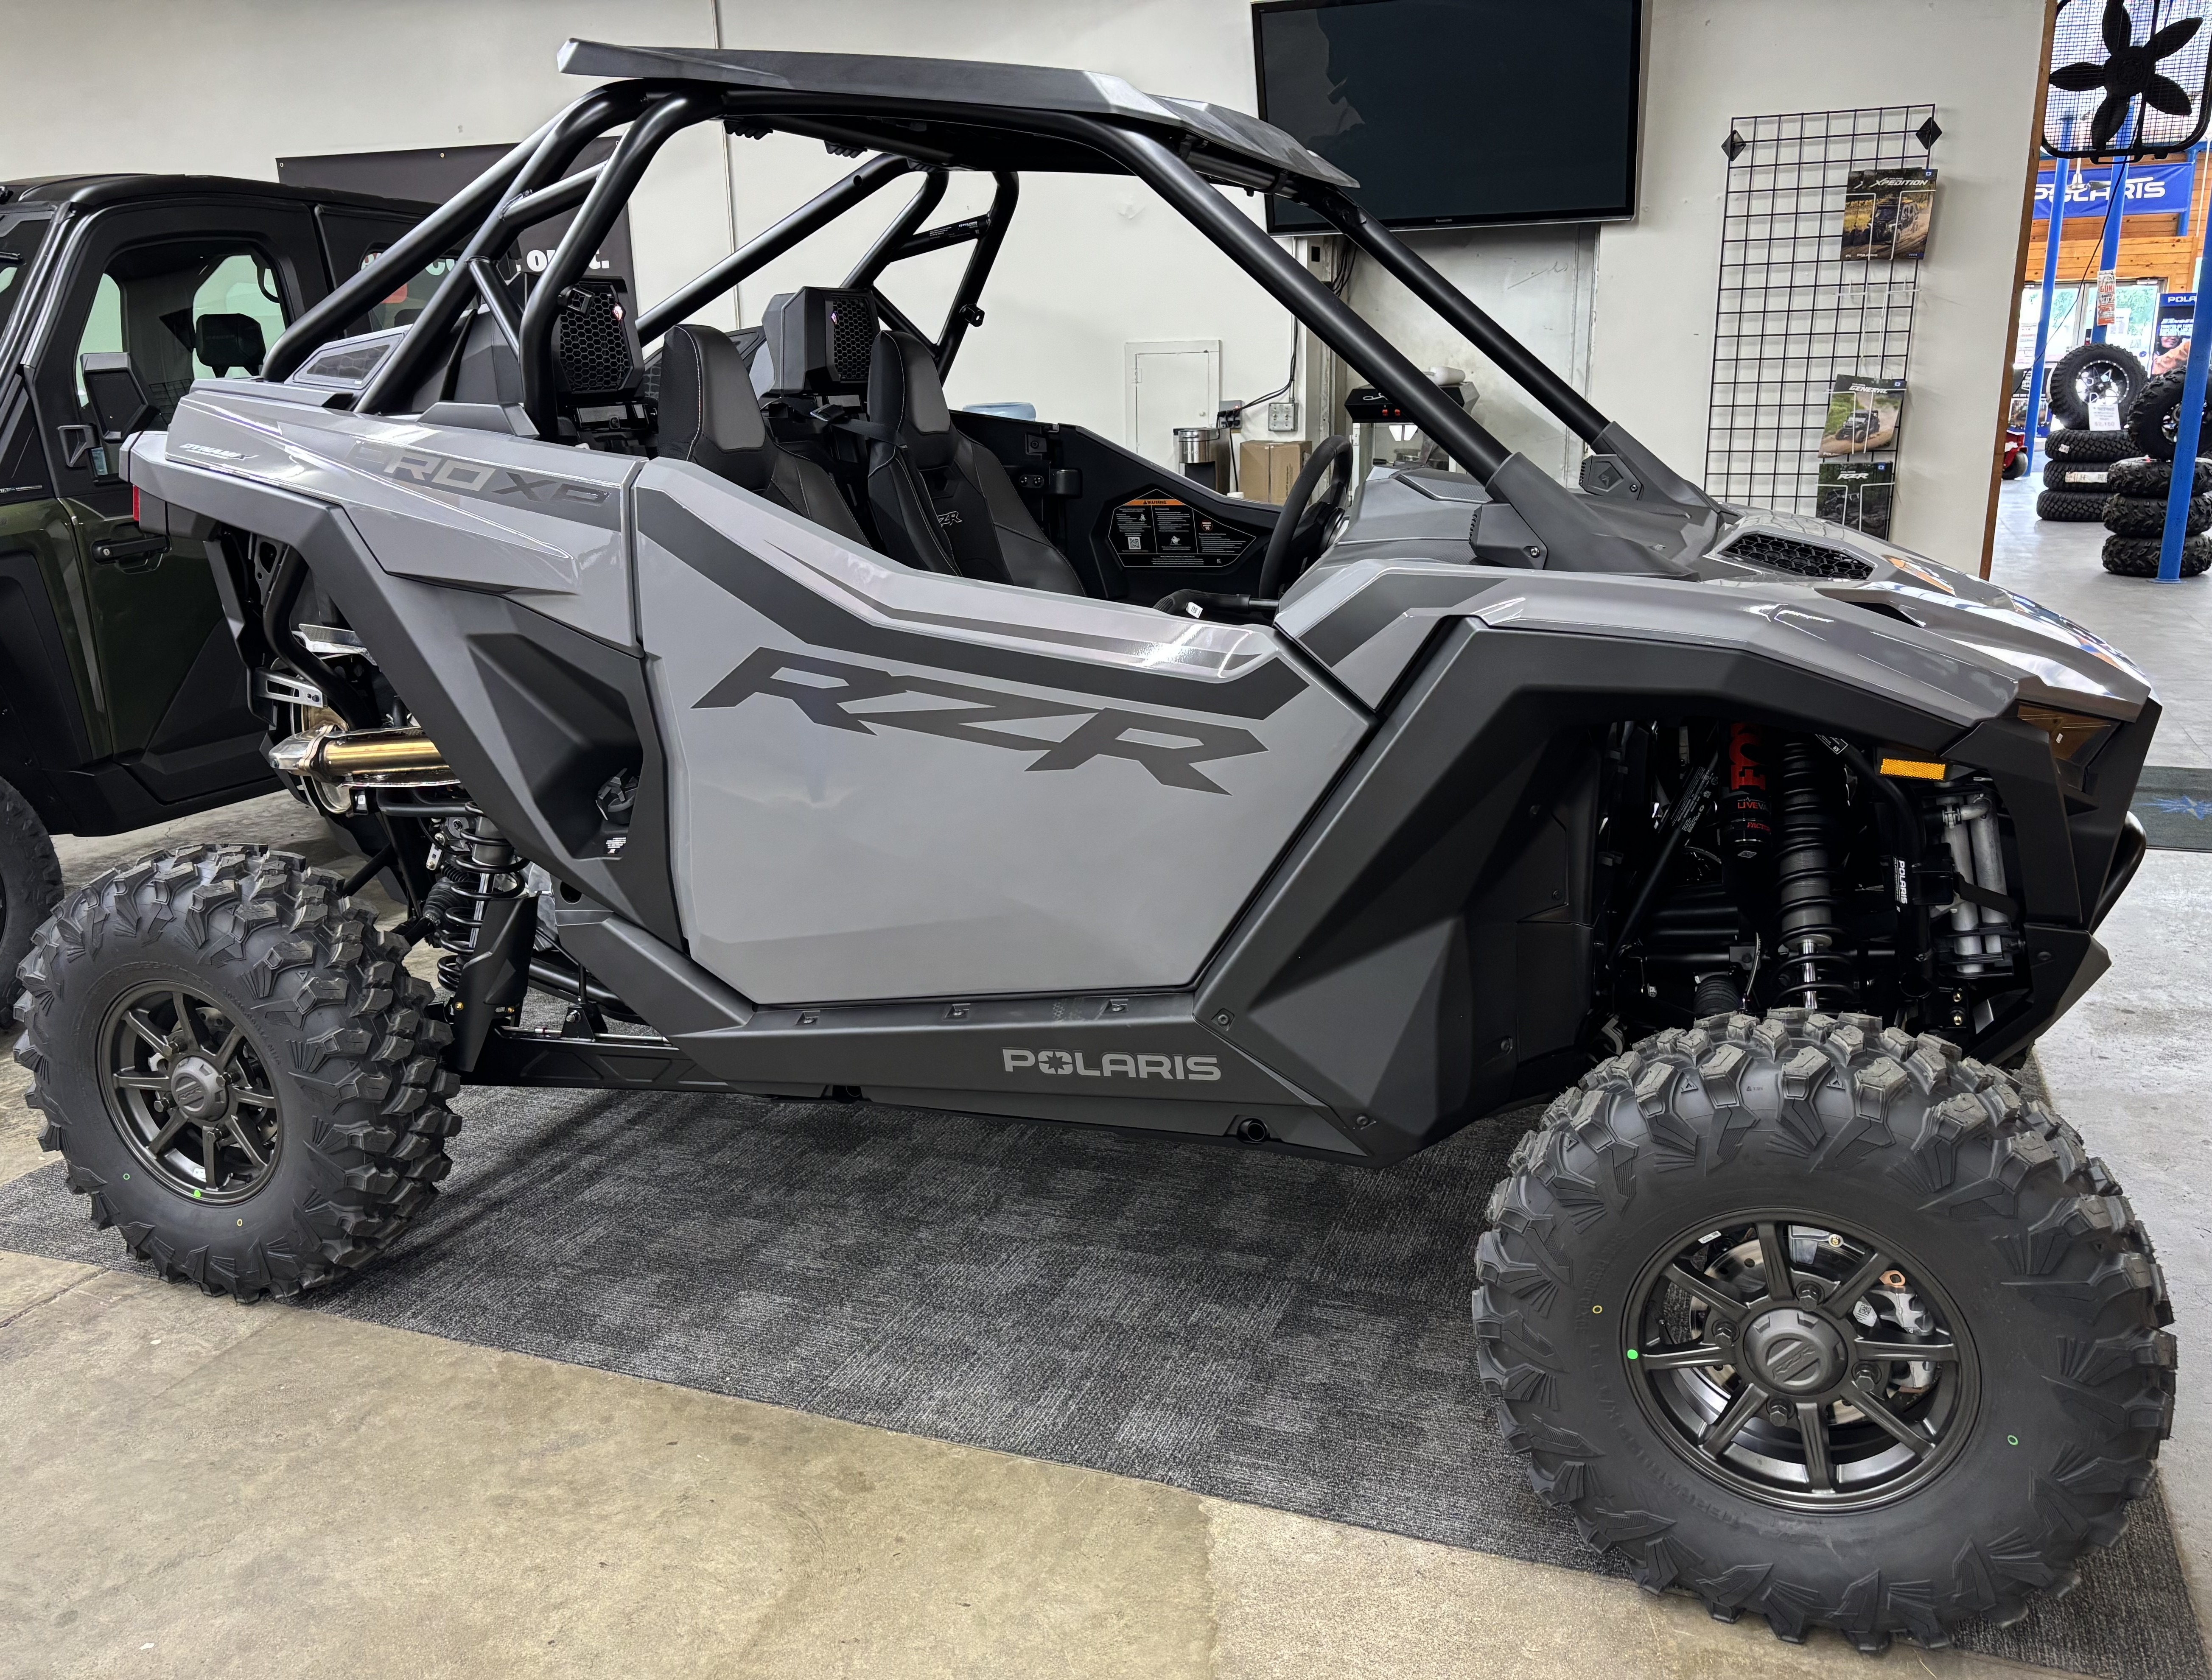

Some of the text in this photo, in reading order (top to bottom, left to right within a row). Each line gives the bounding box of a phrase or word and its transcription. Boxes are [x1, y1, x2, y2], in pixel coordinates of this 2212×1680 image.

[1869, 177, 1929, 187] XPEDITION
[1849, 386, 1888, 394] GENERAL
[690, 646, 1269, 796] RZR
[1898, 860, 1908, 904] POLARIS
[1002, 1047, 1221, 1081] POLARIS
